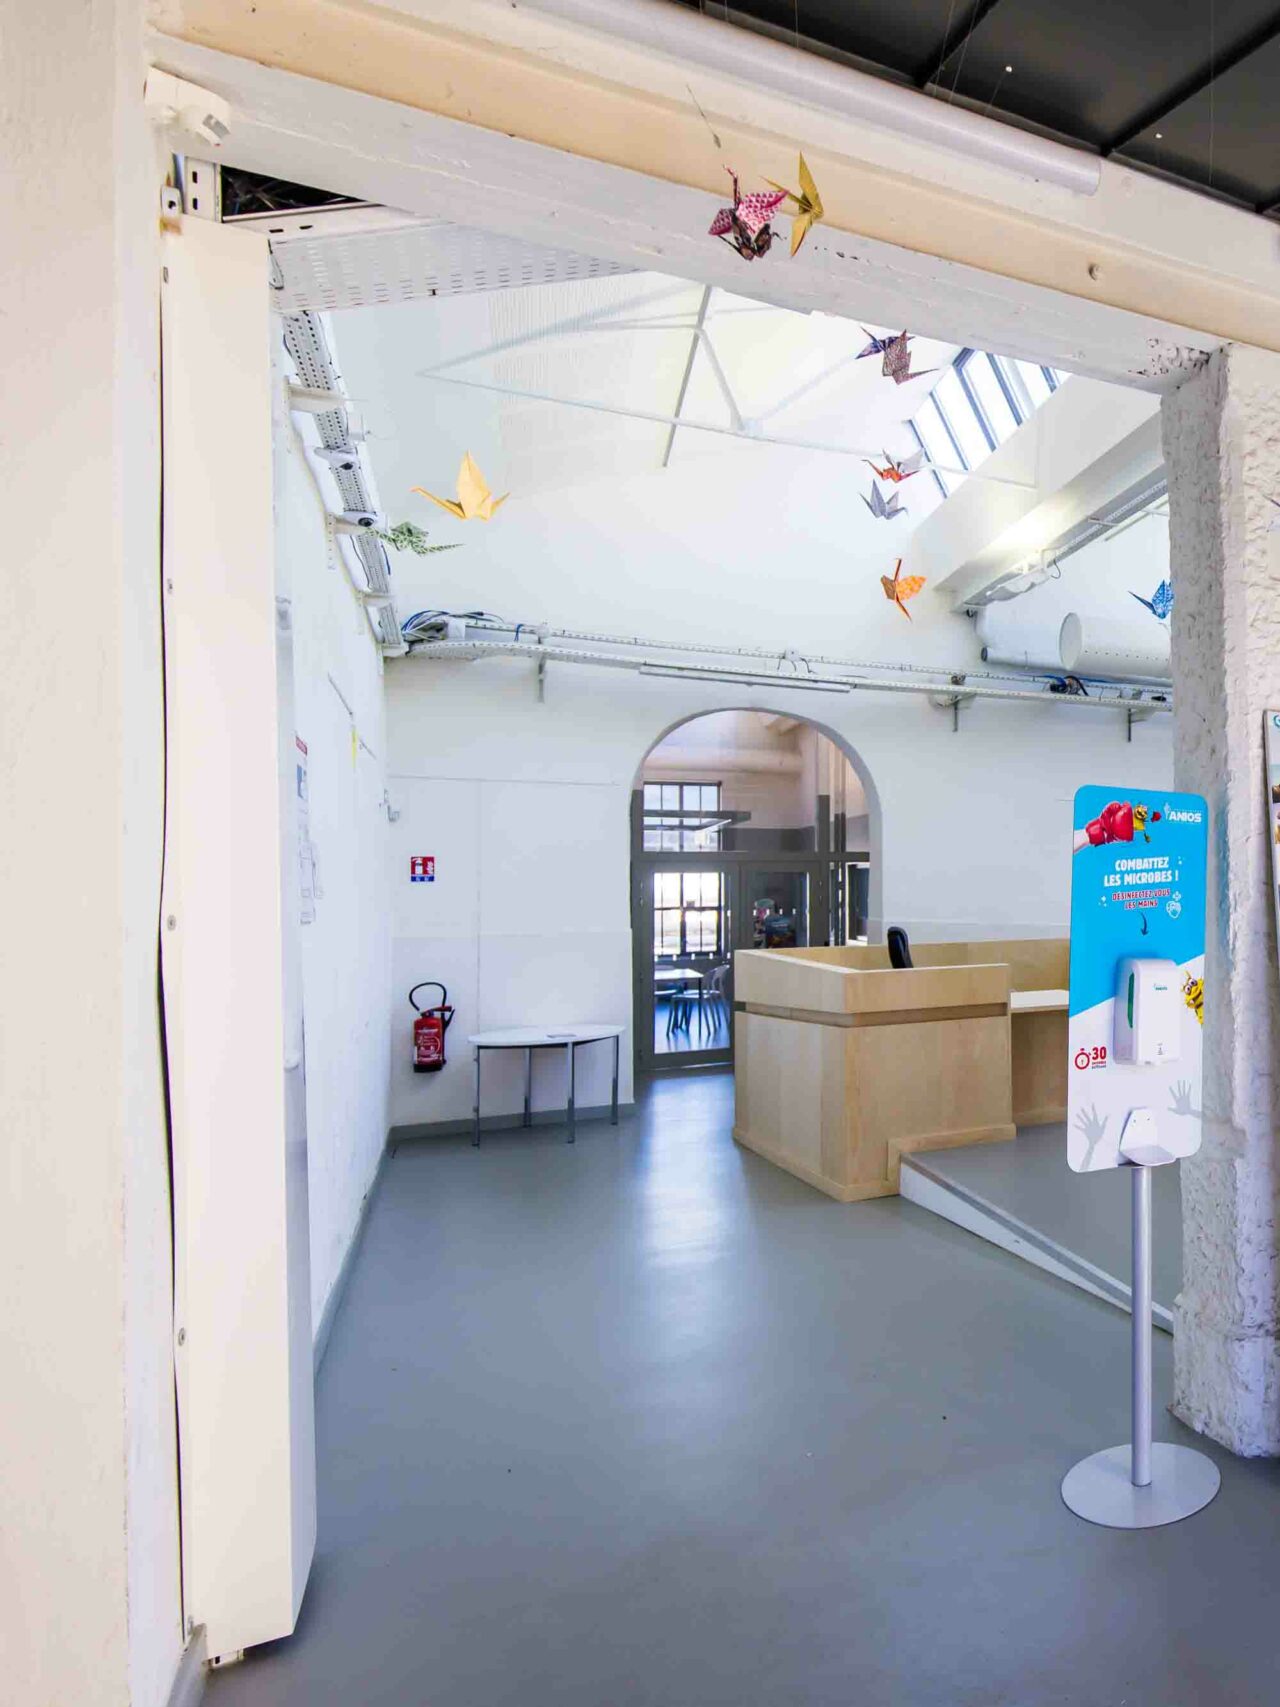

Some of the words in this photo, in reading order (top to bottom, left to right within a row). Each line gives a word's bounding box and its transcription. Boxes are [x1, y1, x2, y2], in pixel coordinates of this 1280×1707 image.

[1169, 811, 1202, 823] ANIOS
[1115, 856, 1169, 872] COMBATTEZ
[1104, 874, 1121, 887] LES
[1124, 870, 1172, 885] MICROBES
[1175, 869, 1179, 881] !
[1125, 901, 1136, 910] LES
[1138, 899, 1158, 909] MAINS
[1092, 1046, 1107, 1060] 30
